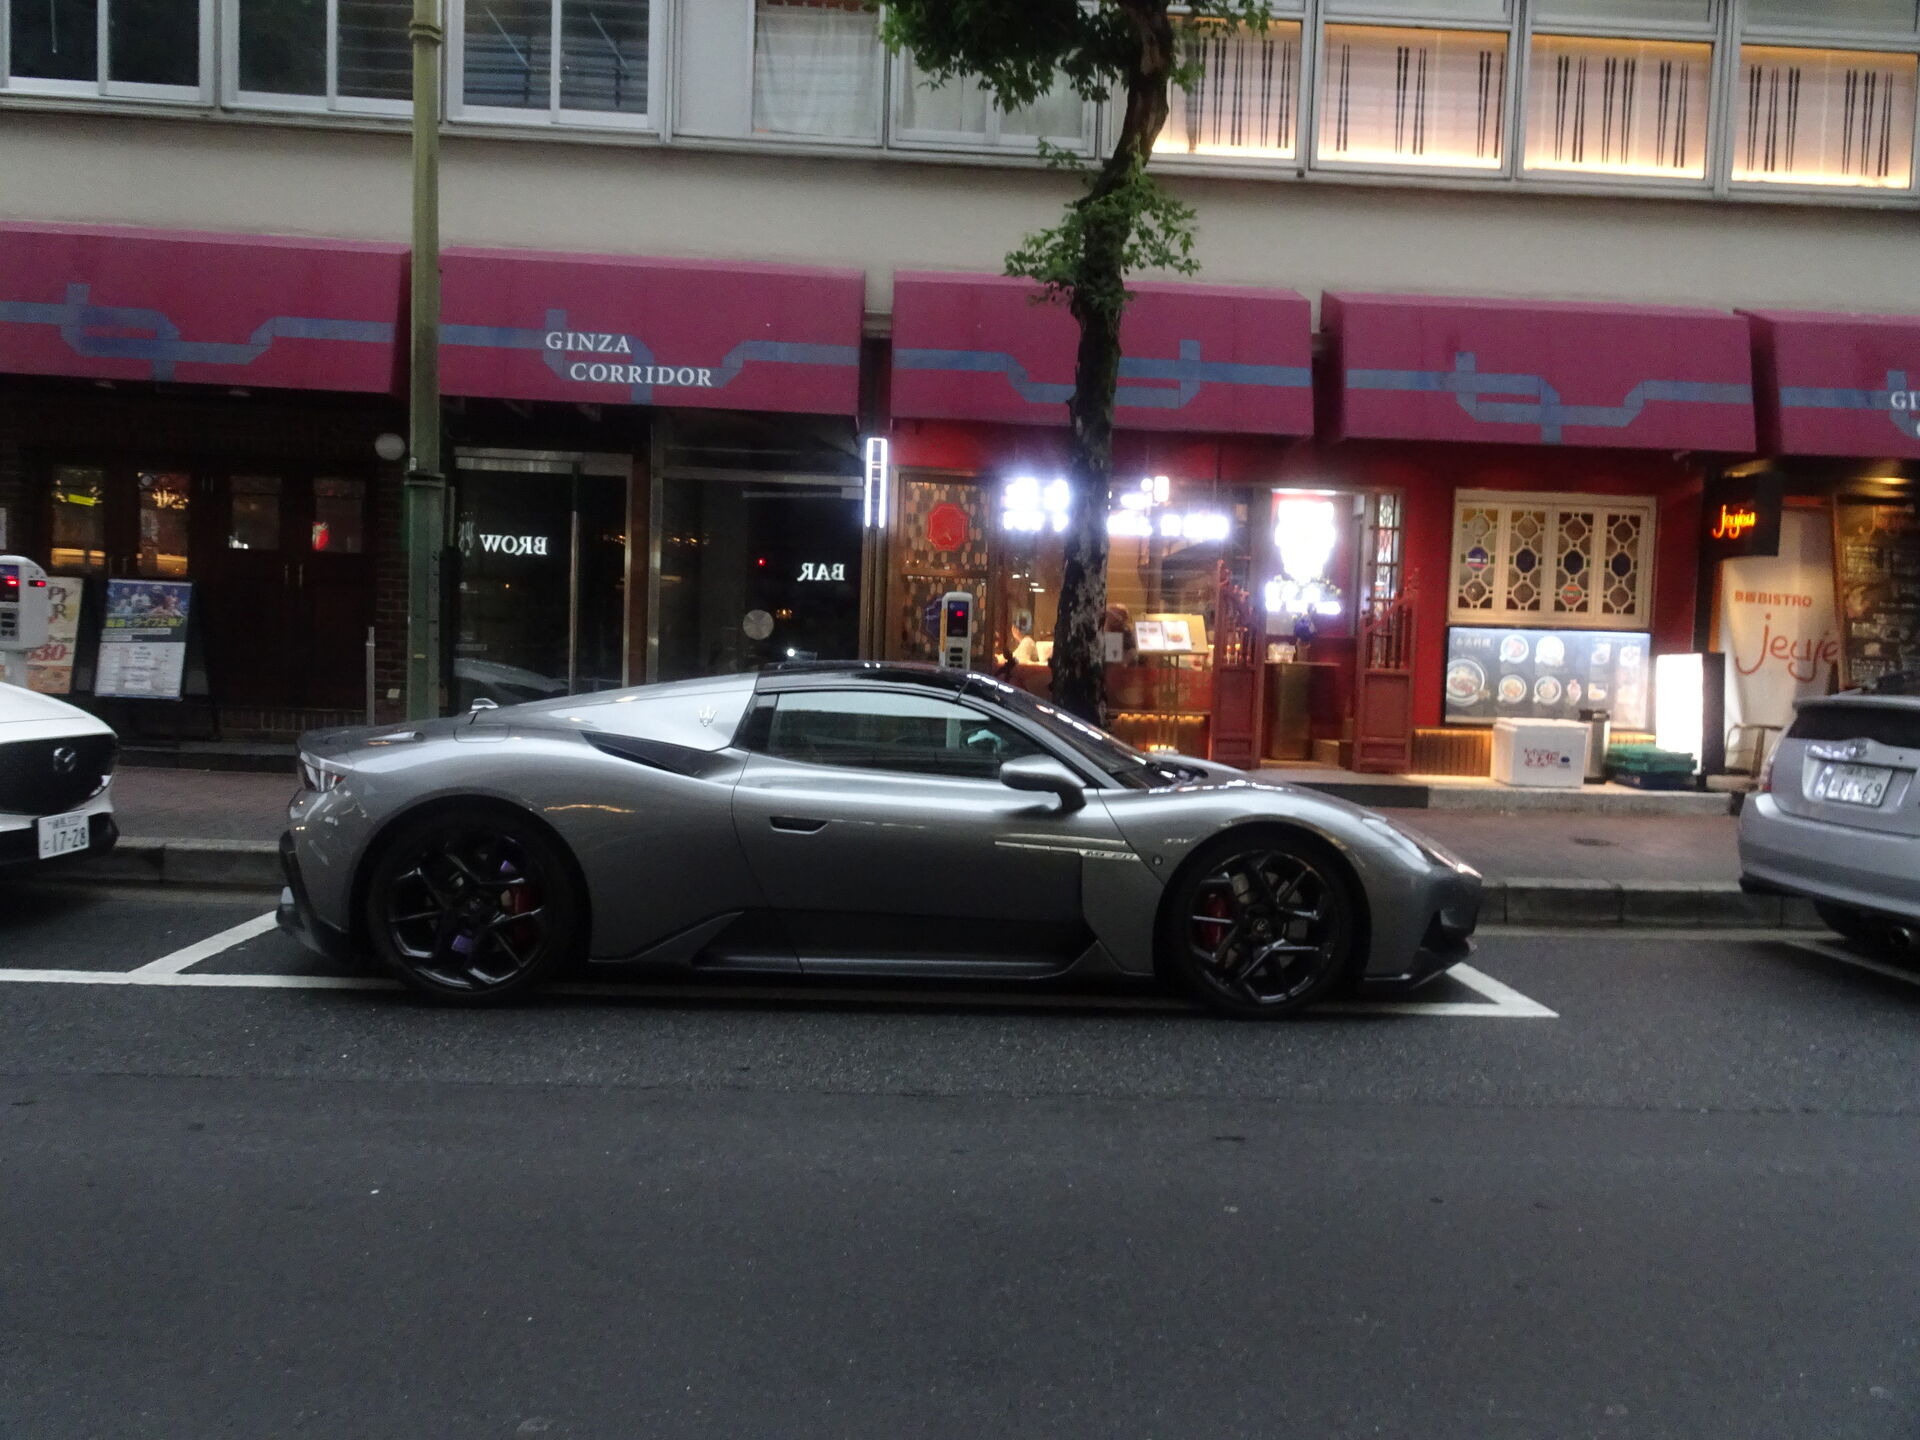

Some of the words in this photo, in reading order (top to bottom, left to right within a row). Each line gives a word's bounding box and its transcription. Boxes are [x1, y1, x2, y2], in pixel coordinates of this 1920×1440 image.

[545, 331, 632, 354] GINZA
[570, 362, 712, 387] CORRIDOR
[53, 826, 87, 852] 17-28
